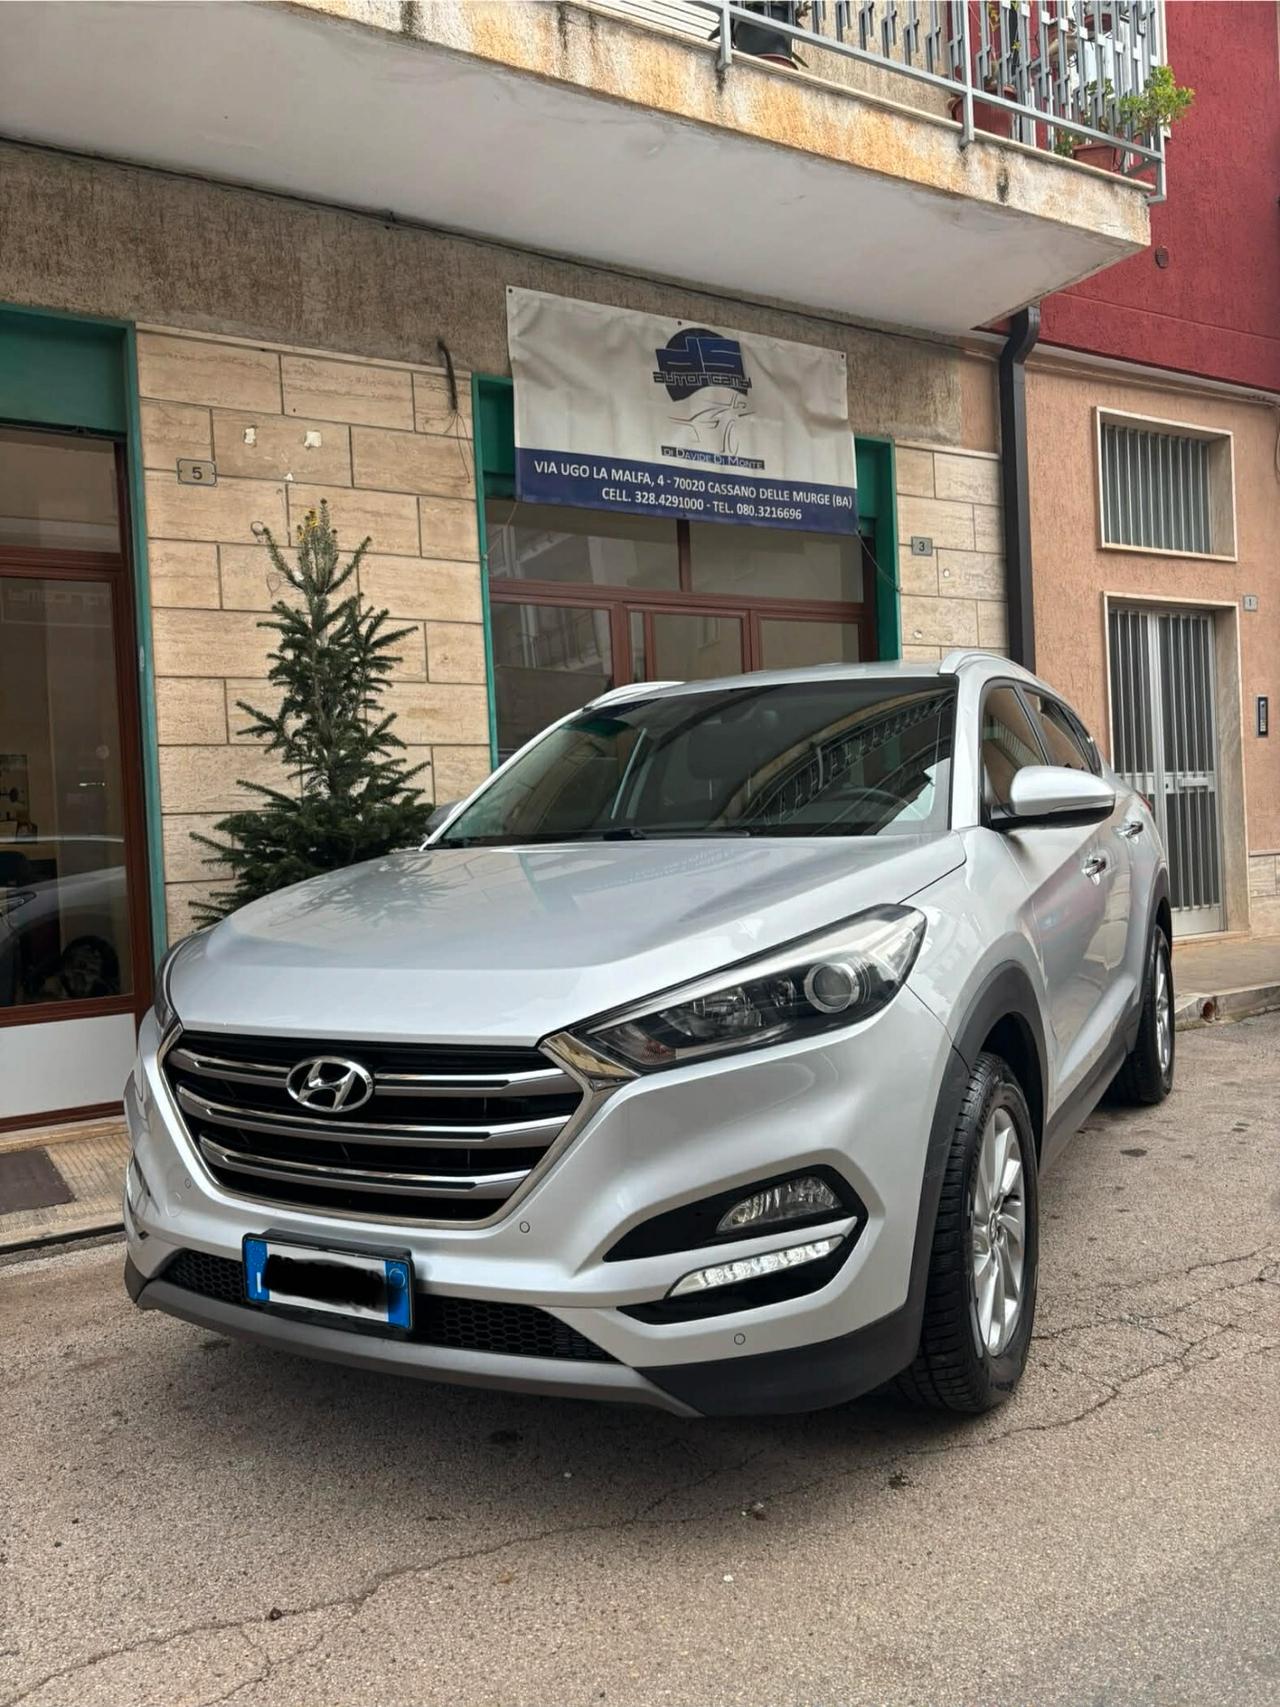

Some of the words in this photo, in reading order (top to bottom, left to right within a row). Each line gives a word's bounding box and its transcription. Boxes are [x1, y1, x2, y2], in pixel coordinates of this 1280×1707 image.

[192, 466, 203, 480] 5
[534, 460, 557, 474] VIA
[561, 464, 590, 478] UGO
[593, 466, 608, 480] LA
[611, 469, 655, 487] MALFA,
[657, 474, 664, 486] 4
[674, 476, 705, 492] 70020
[707, 482, 757, 498] CASSANO
[759, 488, 790, 502] DELLE
[793, 491, 830, 505] MURGE
[832, 494, 853, 510] (BA)
[602, 487, 631, 502] CELL.
[635, 490, 704, 511] 328.4291000
[712, 501, 734, 514] TEL.
[736, 503, 802, 521] 080.3216696
[918, 541, 926, 552] 3
